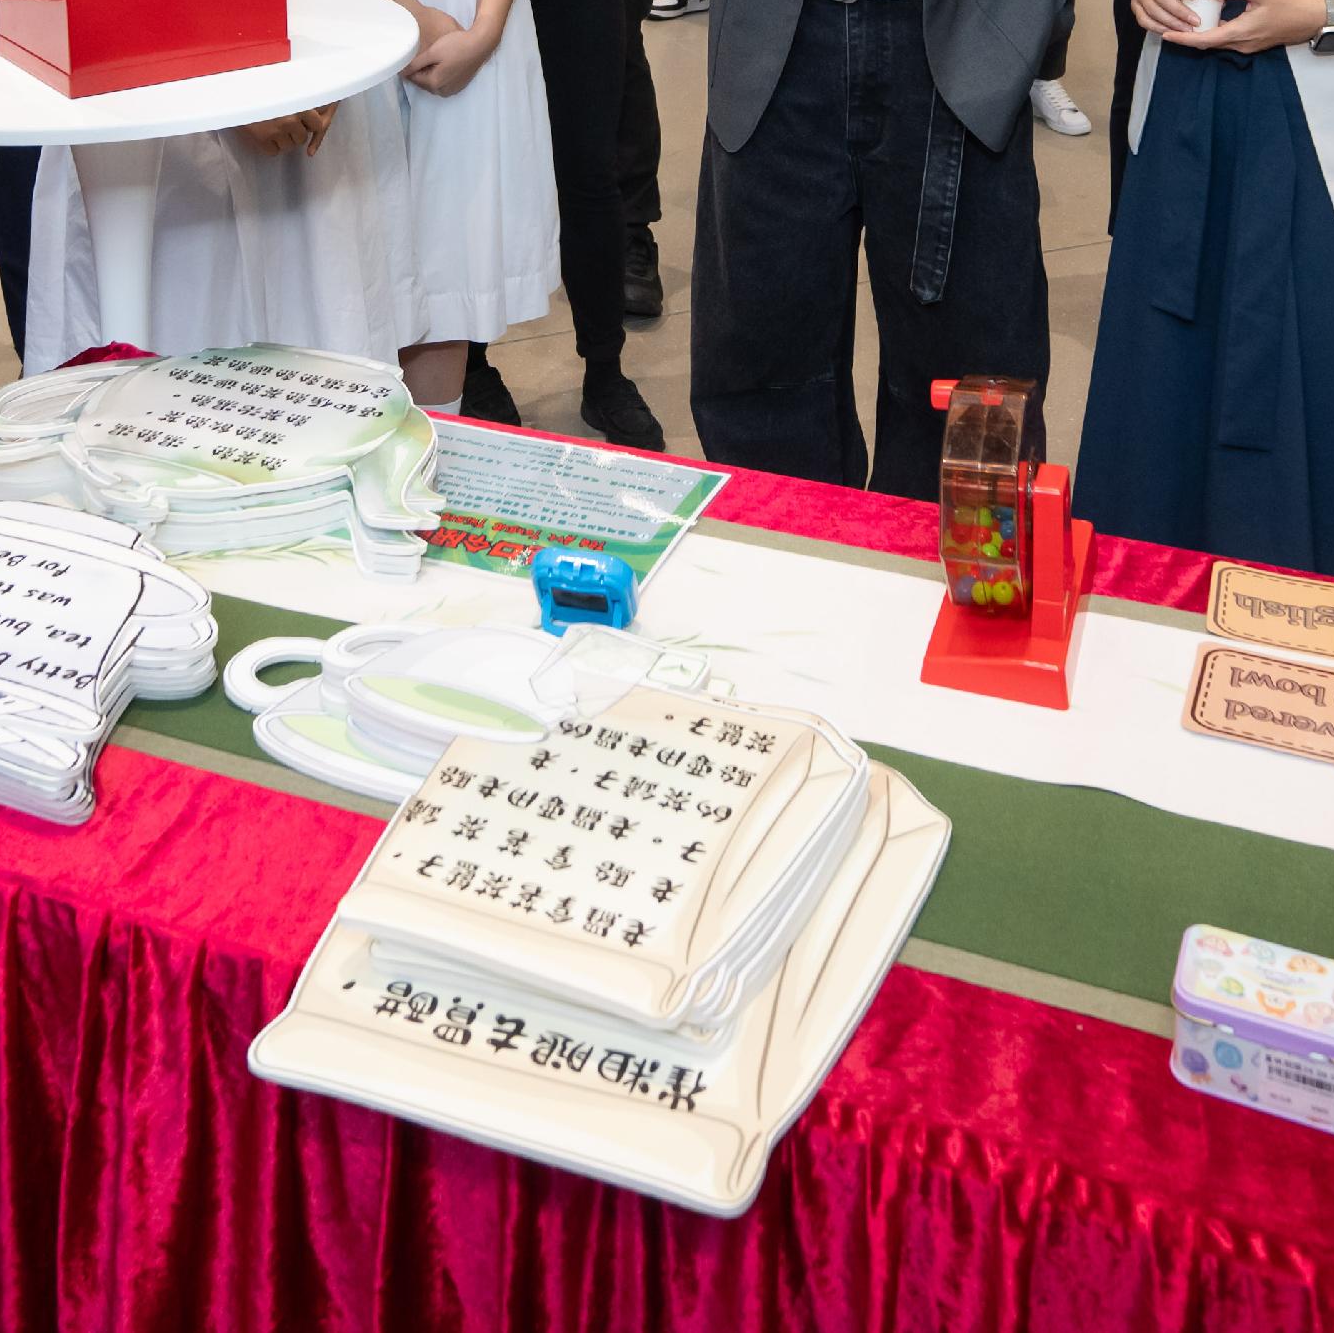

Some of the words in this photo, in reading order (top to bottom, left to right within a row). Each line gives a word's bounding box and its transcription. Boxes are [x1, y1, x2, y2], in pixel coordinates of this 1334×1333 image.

[37, 560, 71, 577] for
[25, 589, 71, 606] was
[46, 625, 92, 648] tea,
[16, 657, 95, 689] Betty
[1230, 666, 1326, 707] bowl
